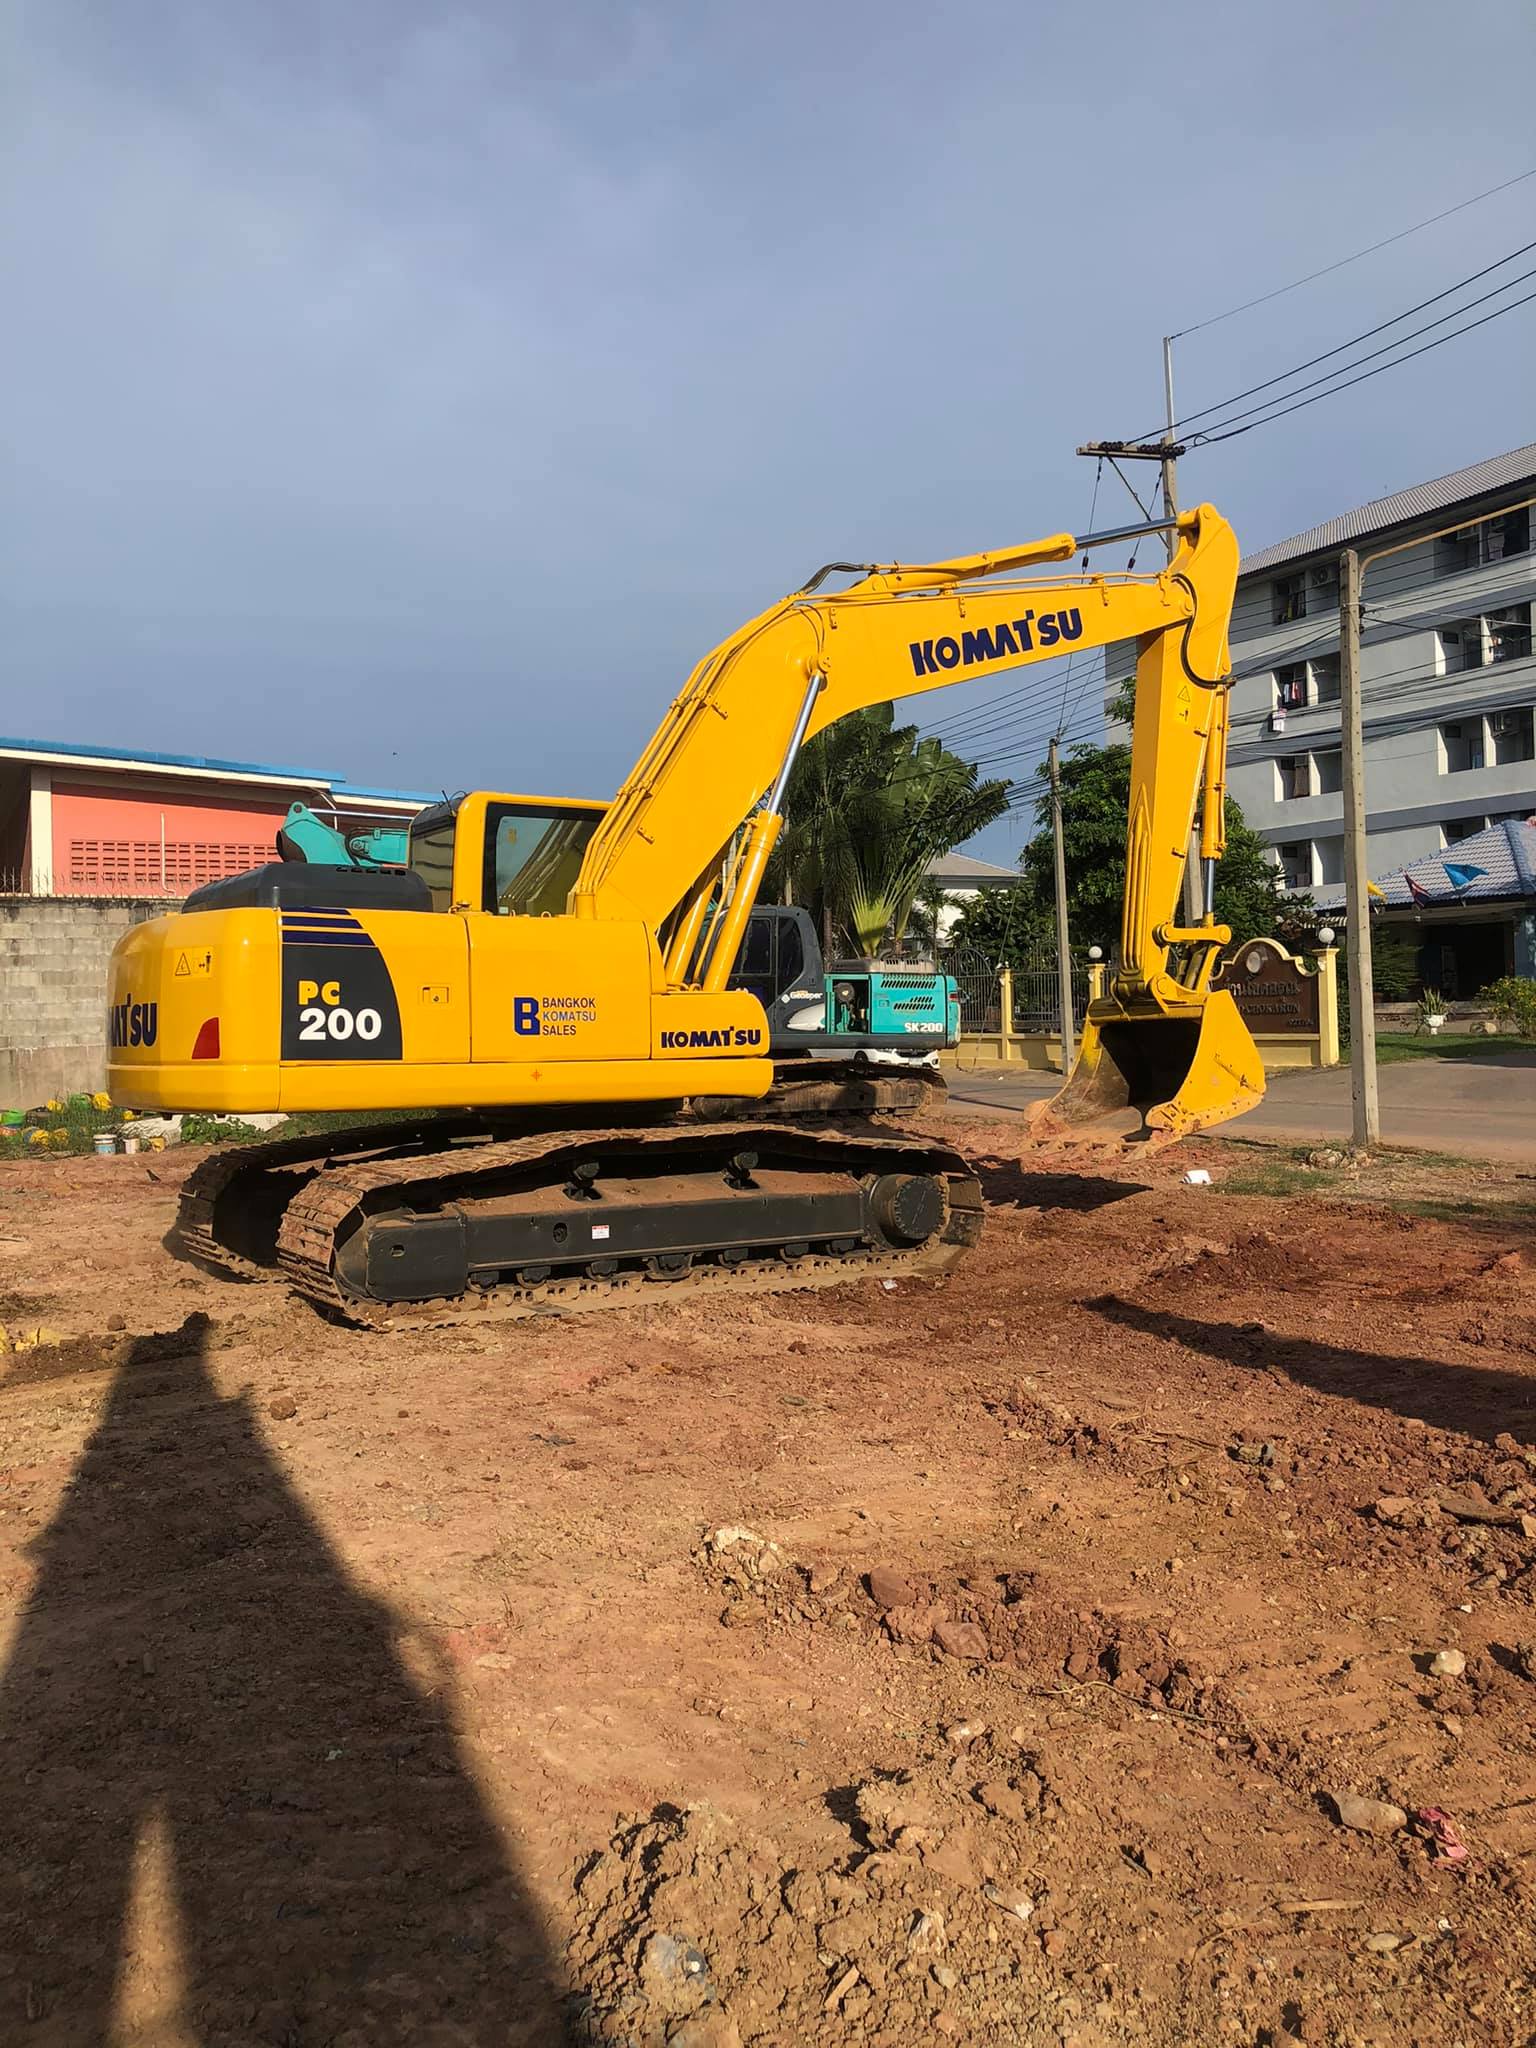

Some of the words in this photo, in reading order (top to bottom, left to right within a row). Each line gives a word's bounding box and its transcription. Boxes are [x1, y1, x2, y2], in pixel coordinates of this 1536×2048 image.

[909, 607, 1083, 677] KOMATSU
[298, 980, 340, 1006] PC
[542, 997, 596, 1008] BANGKOK
[299, 1007, 382, 1040] 200
[543, 1011, 596, 1022] KOMATSU
[542, 1024, 576, 1036] SALES
[904, 1022, 943, 1033] SK200
[661, 1025, 761, 1048] KOMATSU
